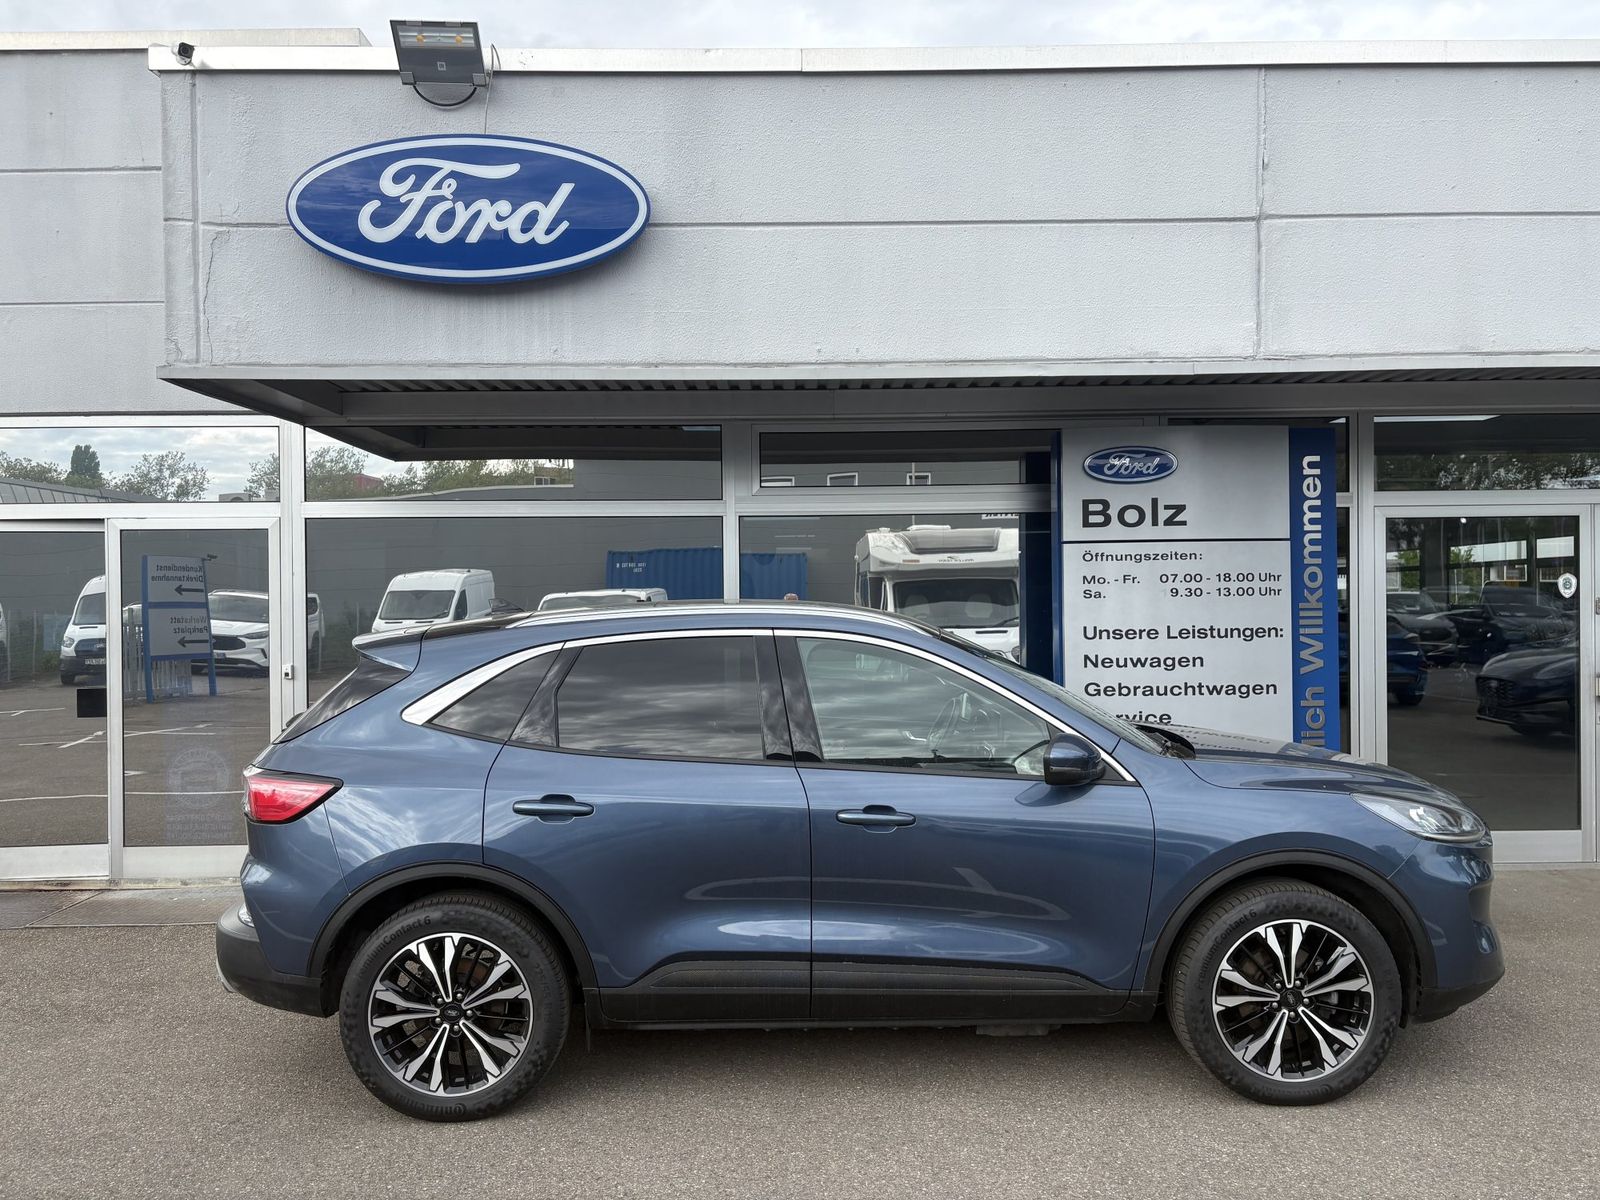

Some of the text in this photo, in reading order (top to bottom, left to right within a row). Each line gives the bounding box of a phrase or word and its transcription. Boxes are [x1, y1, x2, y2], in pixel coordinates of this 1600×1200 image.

[358, 158, 575, 244] Ford
[1103, 453, 1160, 475] Ford
[1081, 497, 1188, 528] Bolz
[1082, 550, 1203, 563] Öffnungszeiten:
[1082, 574, 1111, 585] Mo.
[1122, 574, 1141, 585] Fr.
[1159, 573, 1203, 584] 07.00
[1215, 572, 1255, 583] 18.00
[1258, 572, 1283, 583] Uhr
[1083, 588, 1107, 599] Sa.
[1170, 587, 1203, 598] 9.30
[1215, 586, 1255, 597] 13.00
[1258, 586, 1283, 597] Uhr
[1299, 455, 1326, 746] lich Willkommen
[1082, 624, 1285, 642] Unsere Leistungen:
[1083, 653, 1205, 671] Neuwagen
[1084, 681, 1278, 699] Gebrauchtwagen
[1115, 710, 1172, 724] rvice
